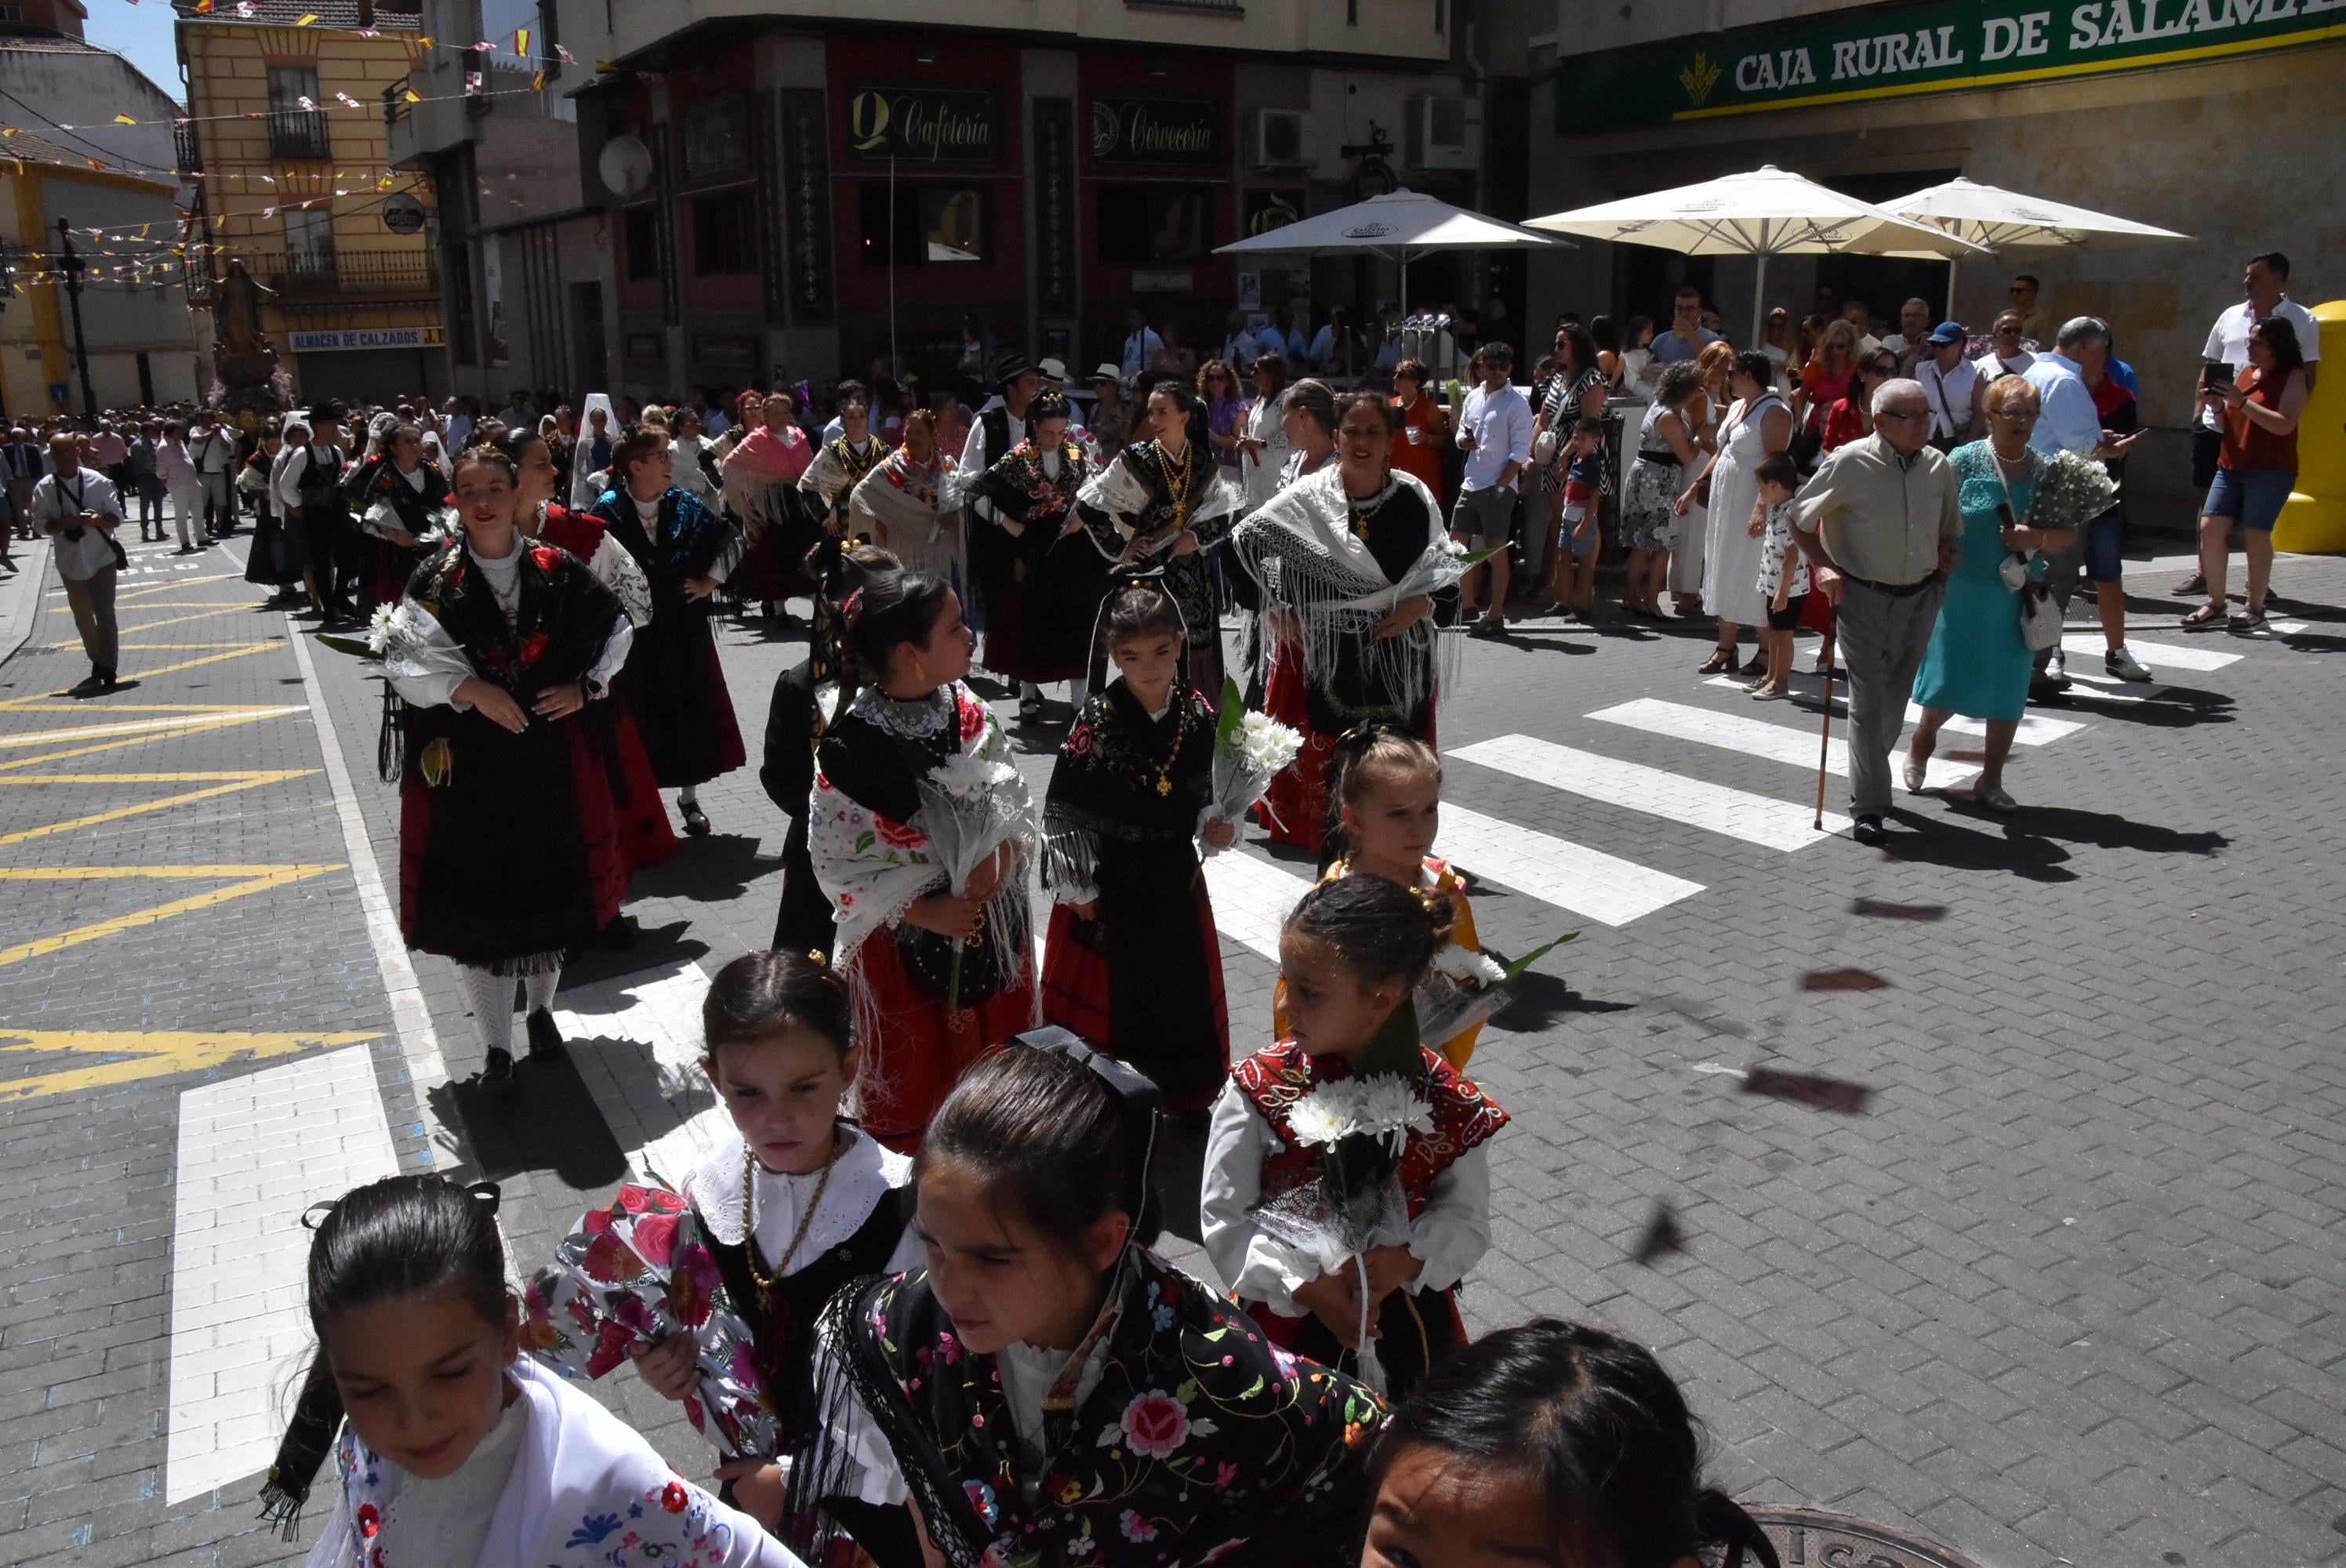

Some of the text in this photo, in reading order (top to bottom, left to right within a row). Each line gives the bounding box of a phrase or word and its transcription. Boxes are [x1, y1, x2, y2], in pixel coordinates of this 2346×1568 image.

[1734, 47, 1818, 92] CAJA
[1831, 24, 1964, 80] RURAL
[1980, 10, 2051, 62] DE
[891, 95, 990, 162] Cafetería
[1119, 101, 1211, 160] Cervecería
[295, 335, 339, 348] ALMACEN
[343, 333, 357, 347] DE
[360, 331, 418, 346] CALZADOS
